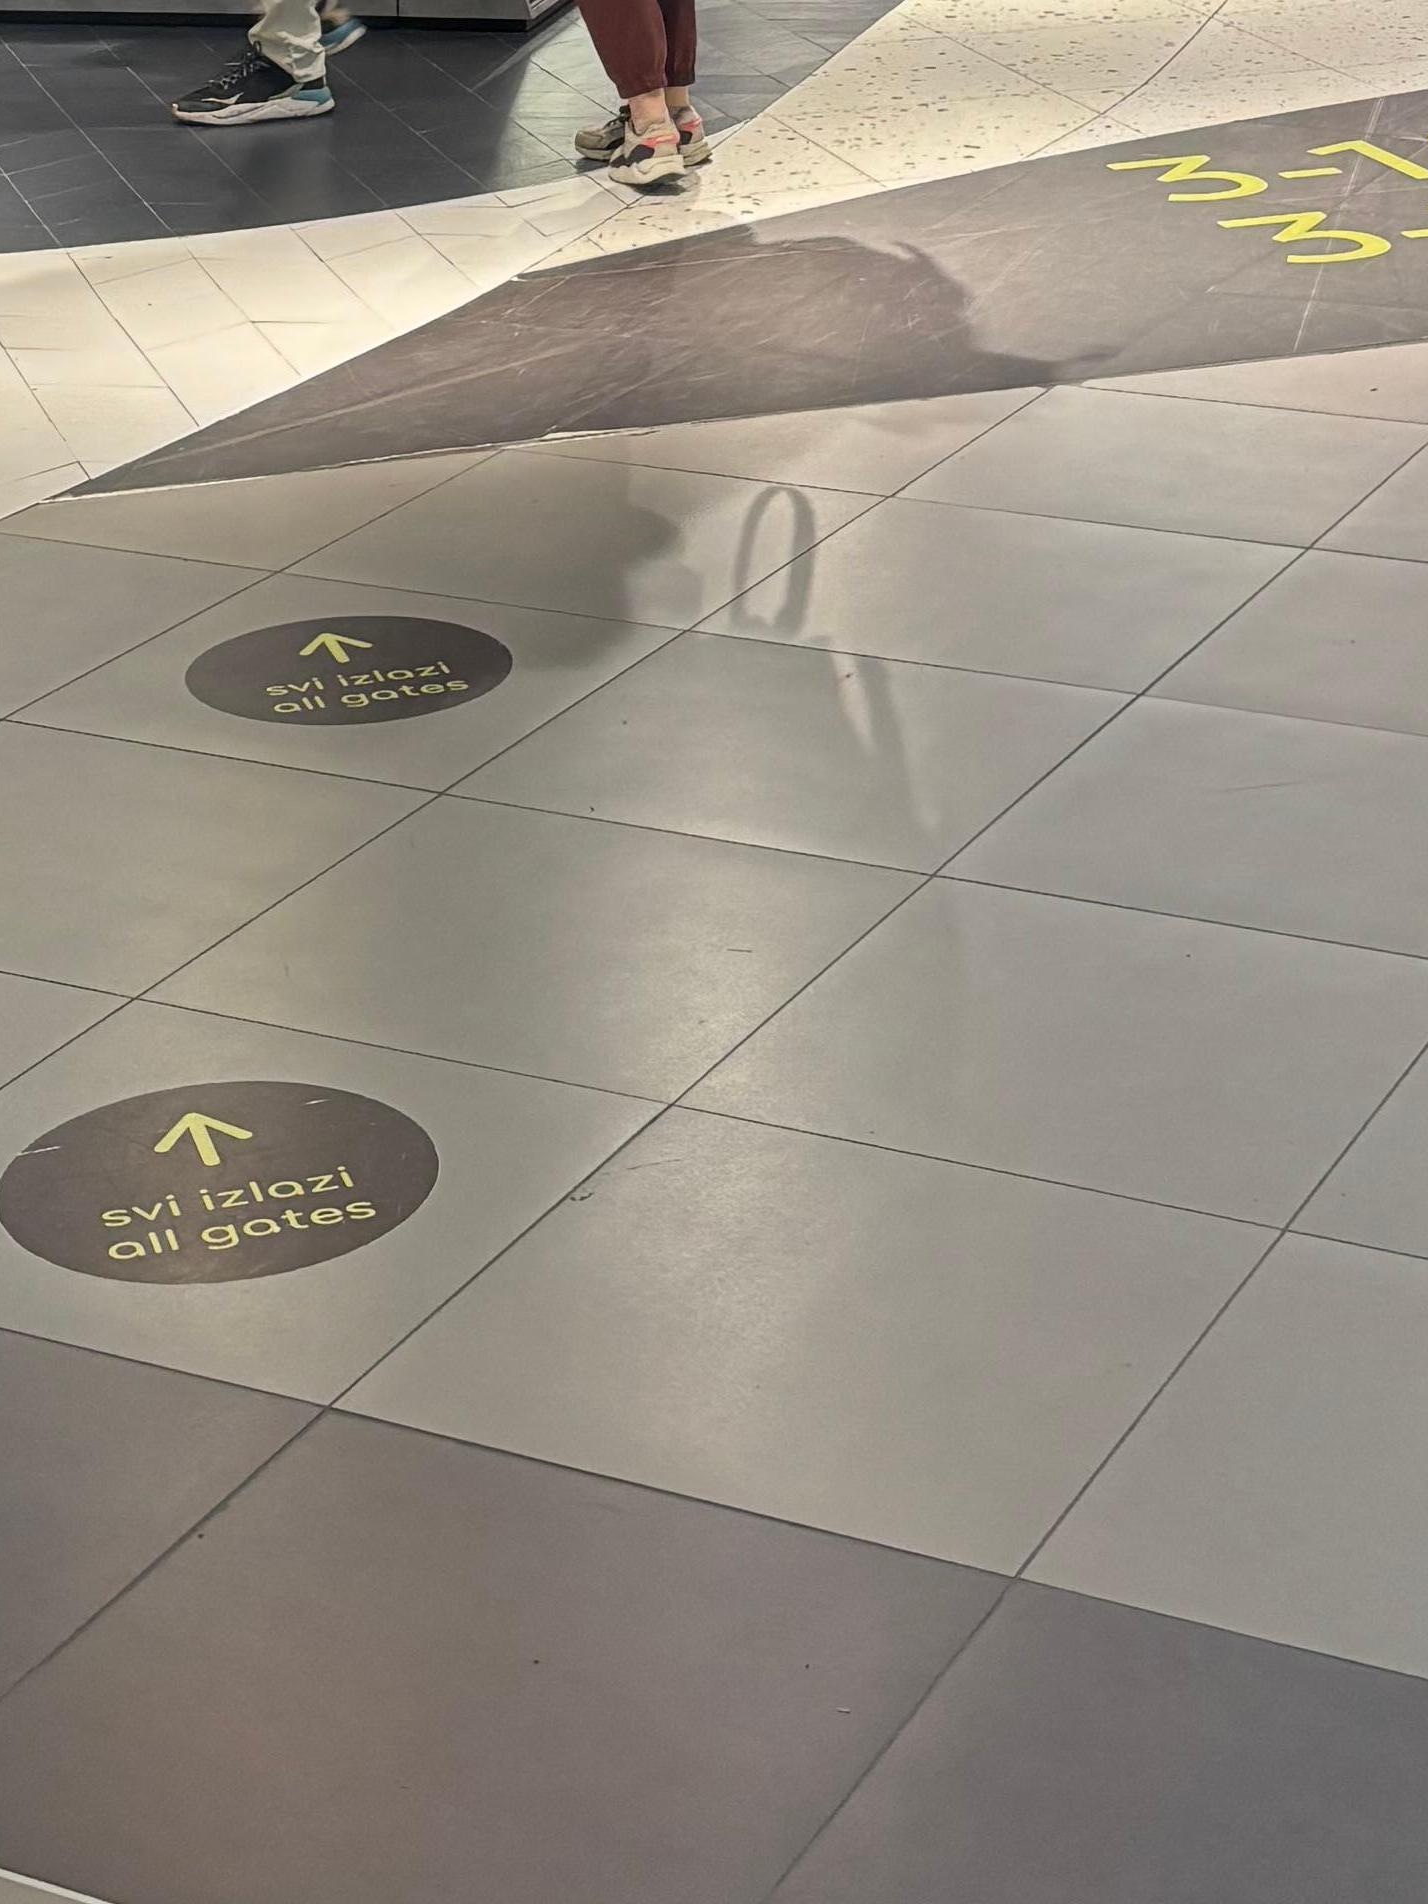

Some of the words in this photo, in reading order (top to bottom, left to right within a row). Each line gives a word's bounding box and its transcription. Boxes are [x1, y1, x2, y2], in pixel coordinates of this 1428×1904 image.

[266, 677, 324, 697] svi
[336, 661, 451, 687] izlazi
[273, 696, 326, 714] all
[340, 679, 469, 708] gates
[101, 1194, 182, 1228] svi
[198, 1166, 355, 1212] izlazi
[108, 1228, 180, 1260] all
[200, 1200, 377, 1250] gates
